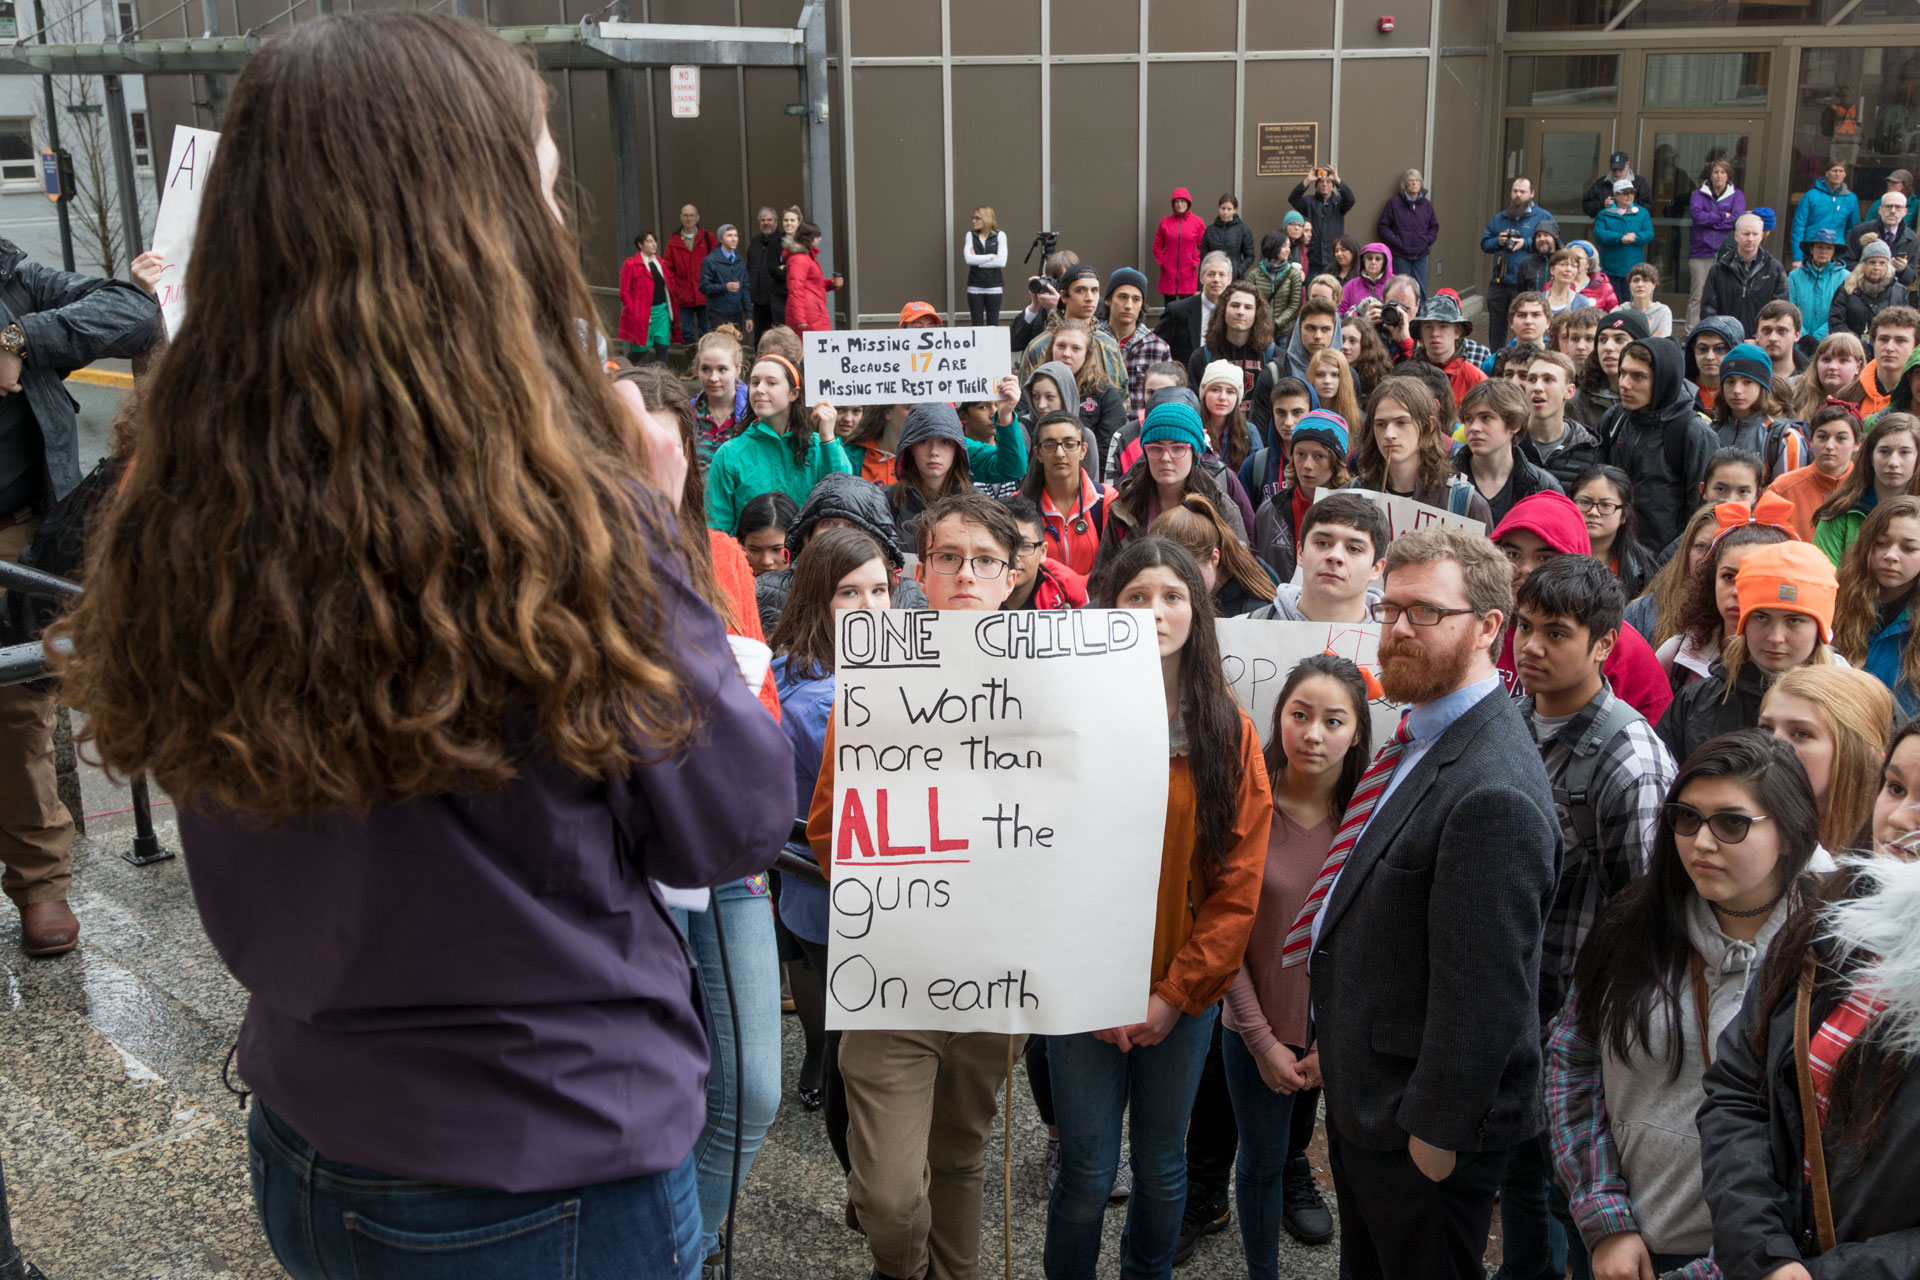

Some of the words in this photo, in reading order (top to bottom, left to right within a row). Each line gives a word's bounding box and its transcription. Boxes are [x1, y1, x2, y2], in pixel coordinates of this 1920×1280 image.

[679, 71, 689, 80] NO
[917, 330, 976, 350] School
[911, 352, 934, 373] 17
[938, 357, 967, 372] ARE
[876, 381, 896, 394] THE
[901, 378, 933, 396] REST
[938, 380, 952, 395] OF
[842, 610, 940, 665] ONE
[974, 610, 1139, 660] CHILD
[839, 744, 943, 772] more
[960, 735, 1042, 770] than
[837, 787, 969, 860] ALL
[982, 803, 1054, 849] the
[833, 876, 950, 939] guns
[830, 954, 907, 1012] On
[928, 969, 1039, 1011] earth
